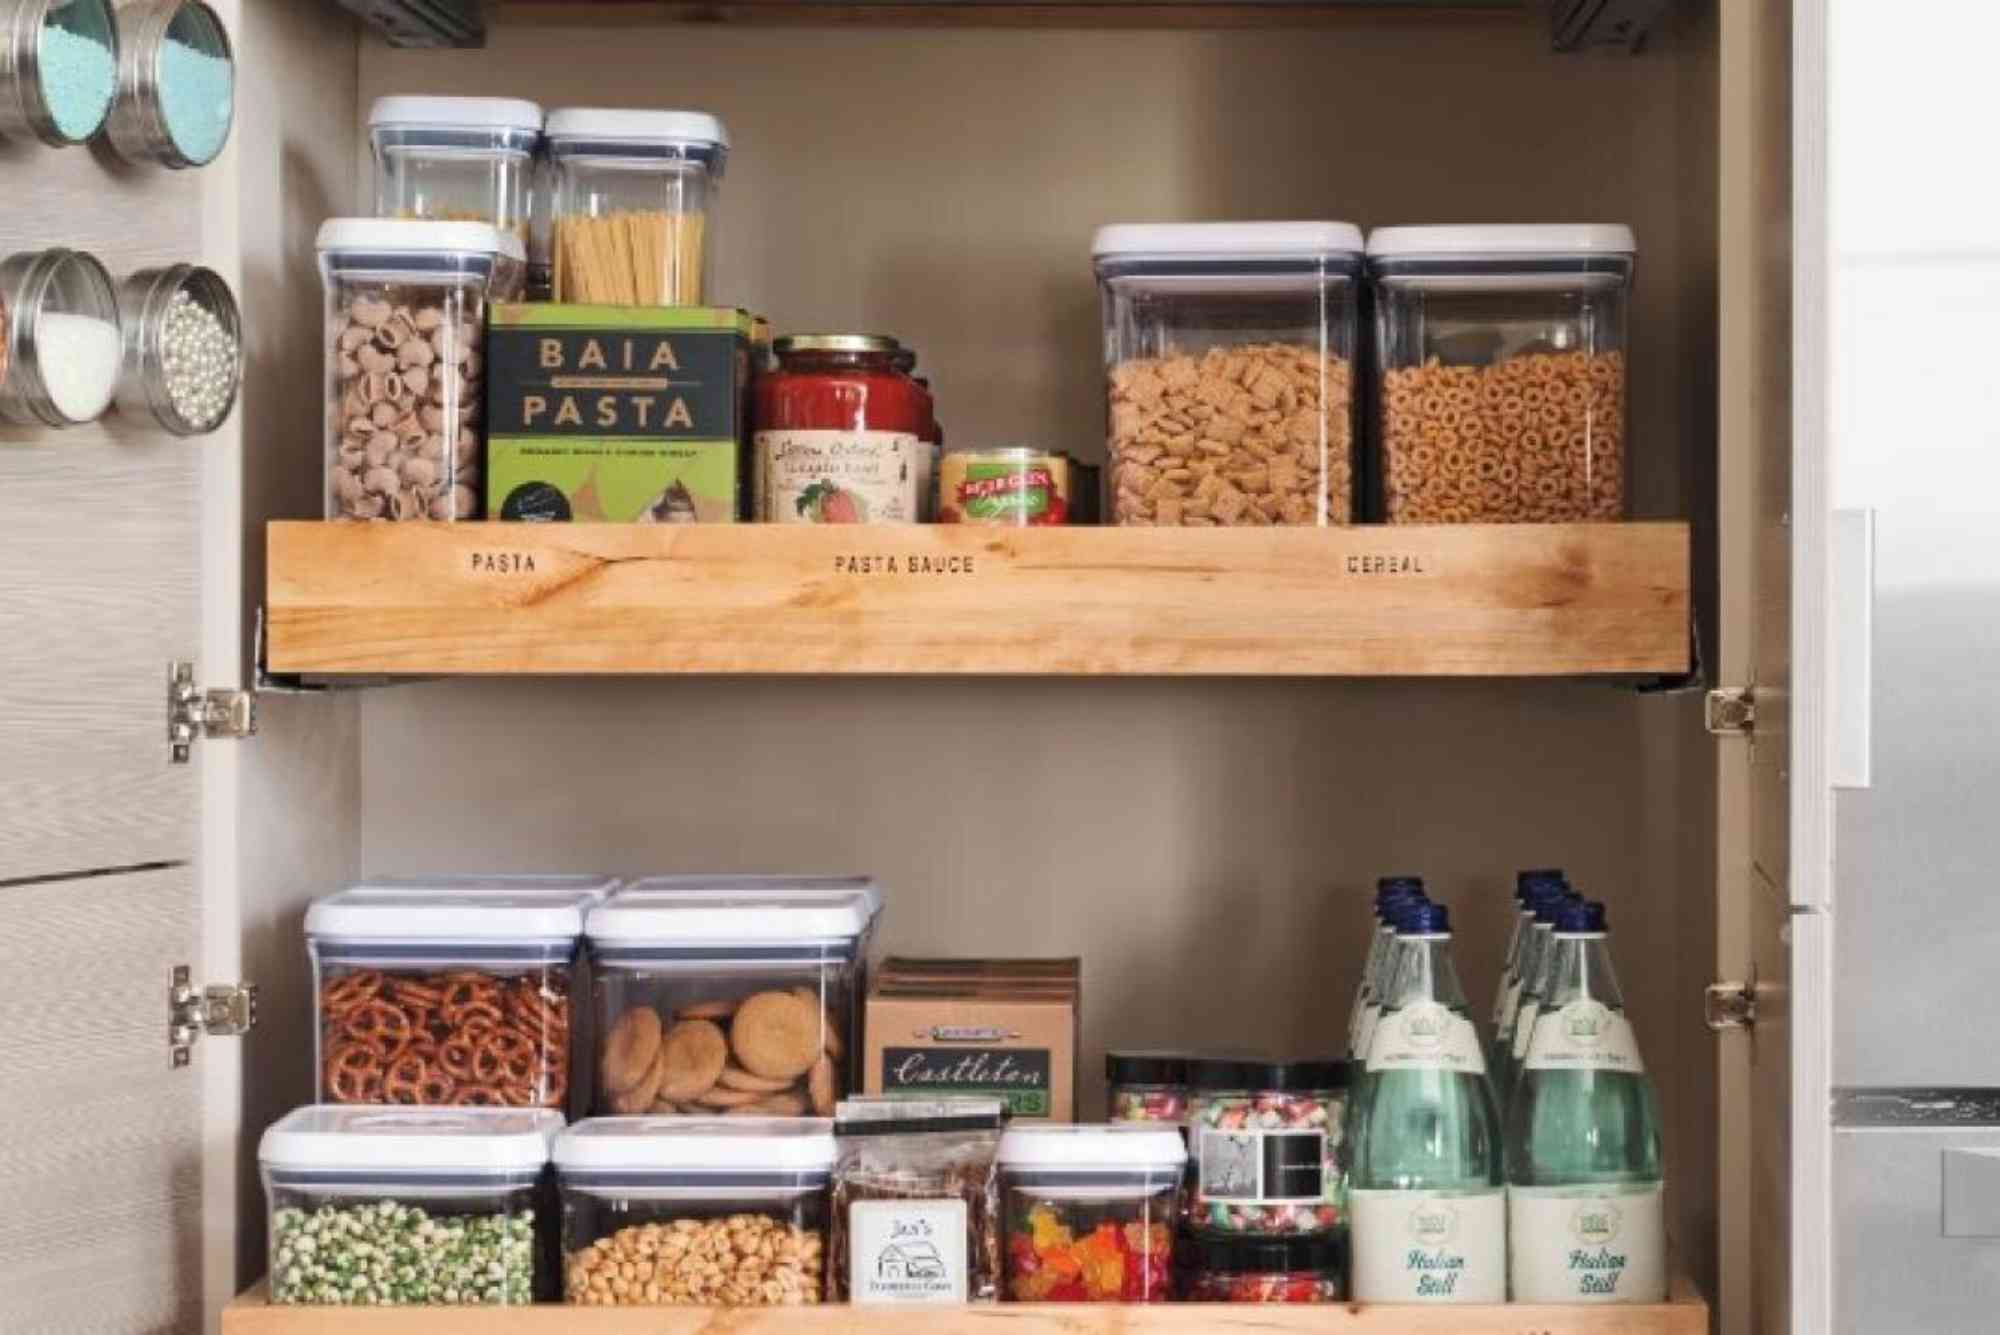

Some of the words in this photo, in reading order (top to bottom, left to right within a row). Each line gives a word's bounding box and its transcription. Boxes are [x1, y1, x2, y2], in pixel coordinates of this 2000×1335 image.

[540, 338, 679, 371] BAIA
[523, 395, 693, 428] PASTA
[471, 553, 535, 573] PASTA
[834, 555, 898, 573] PASTA
[908, 555, 974, 573] SAUCE
[1347, 555, 1424, 573] CEREAL
[893, 1052, 1041, 1085] Castleton
